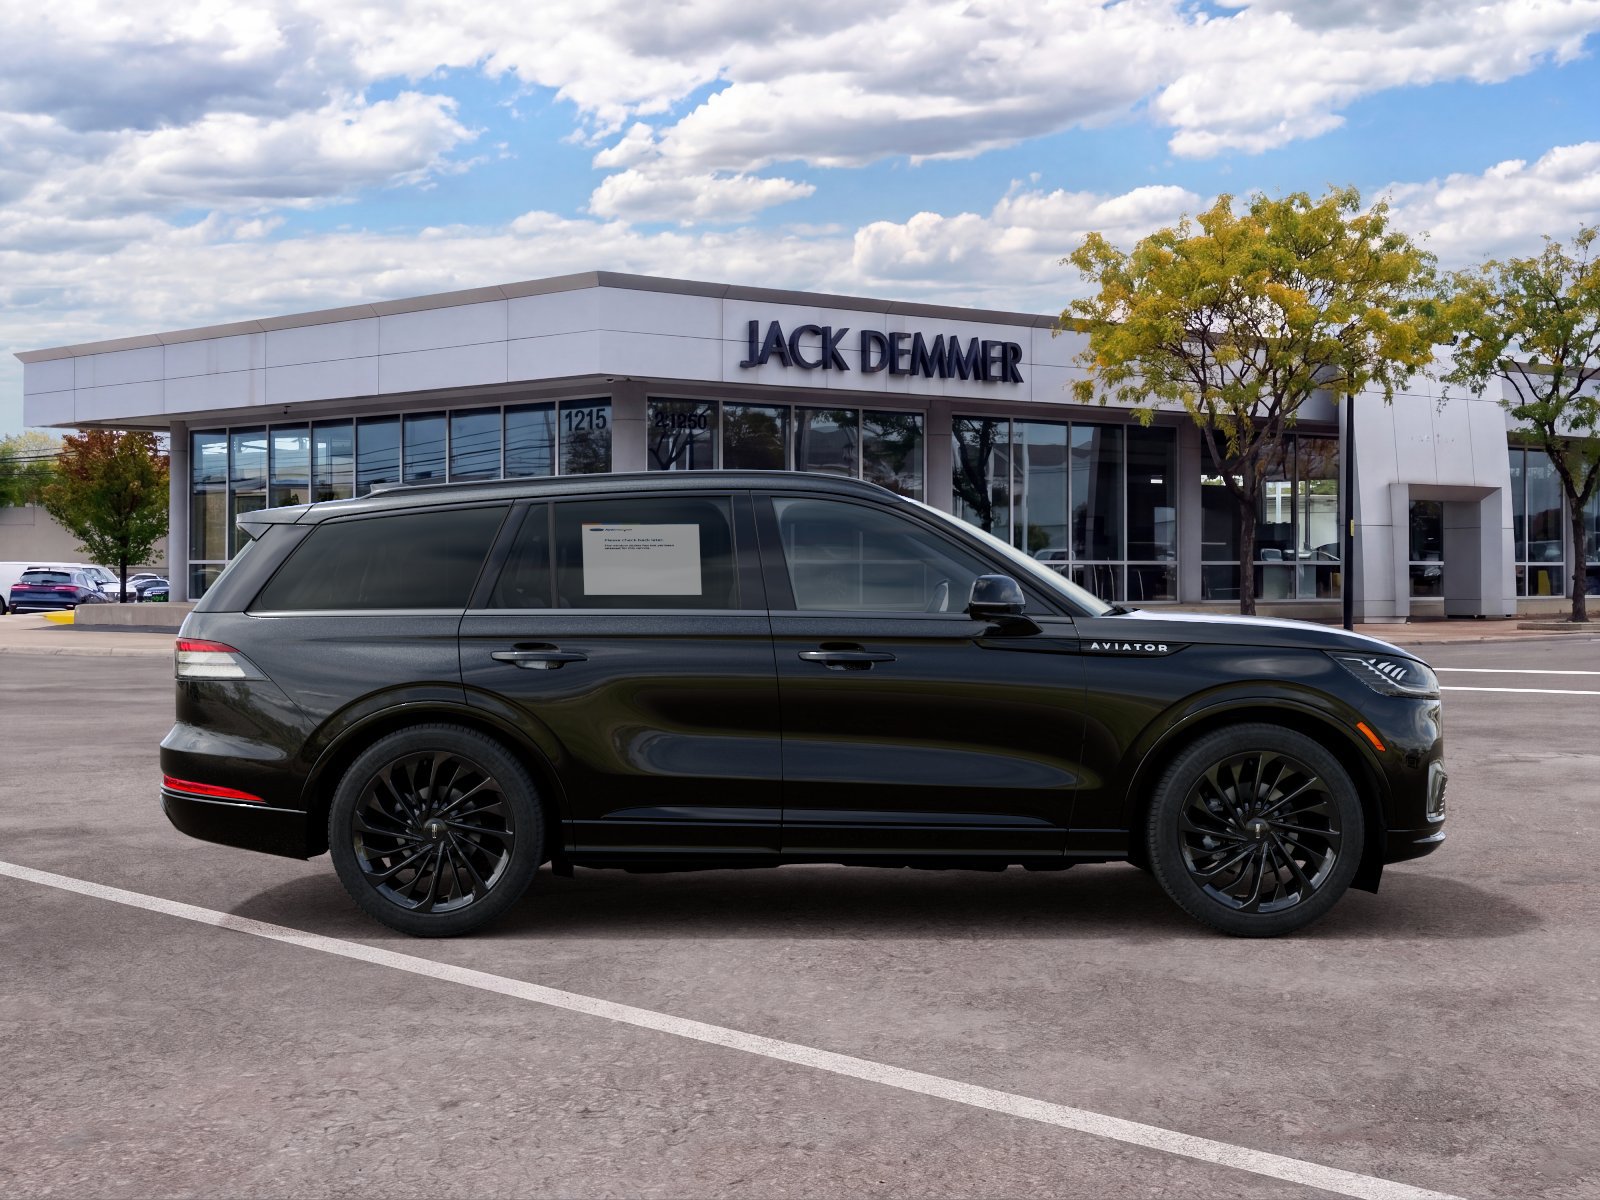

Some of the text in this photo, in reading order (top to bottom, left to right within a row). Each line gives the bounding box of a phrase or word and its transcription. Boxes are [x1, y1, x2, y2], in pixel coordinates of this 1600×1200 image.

[740, 320, 1024, 383] JACK DEMMER
[565, 408, 607, 432] 1215
[1090, 642, 1168, 652] AVIATOR
